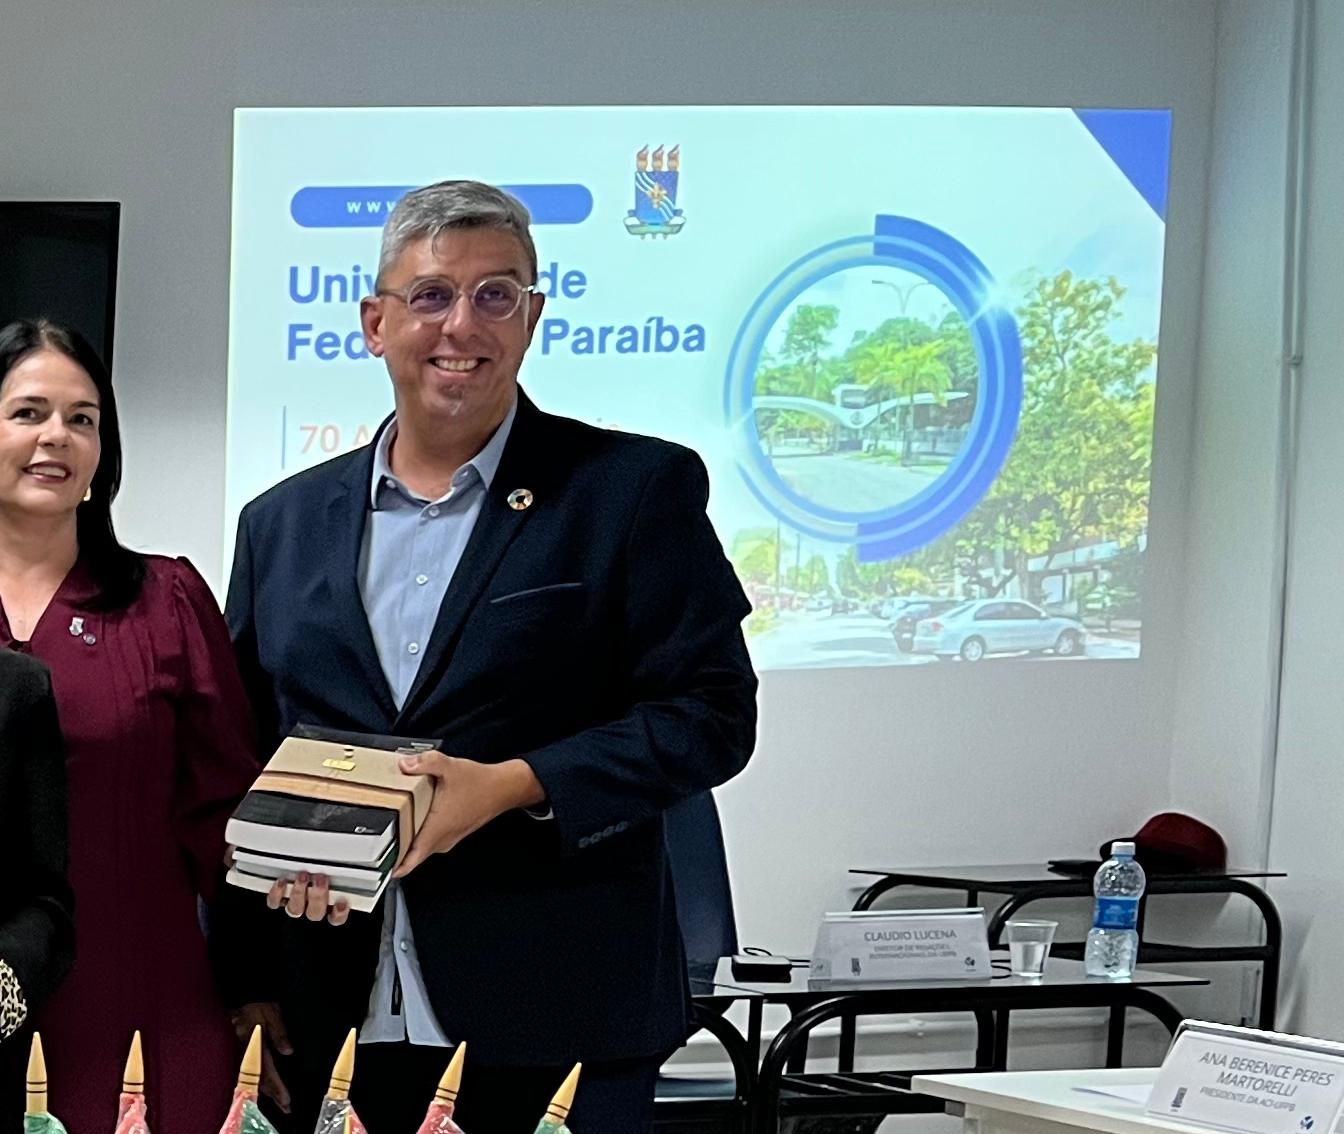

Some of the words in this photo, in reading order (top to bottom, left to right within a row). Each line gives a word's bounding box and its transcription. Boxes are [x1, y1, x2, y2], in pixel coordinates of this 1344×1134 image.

[541, 315, 706, 356] Paraíba
[299, 424, 340, 454] 70
[863, 931, 912, 942] CLAUDIO
[914, 929, 958, 941] LUCENA
[1199, 1051, 1229, 1068] ANA
[1228, 1056, 1293, 1080] BERENICE
[1292, 1067, 1335, 1087] PERES
[1216, 1071, 1298, 1097] MARTORELLI
